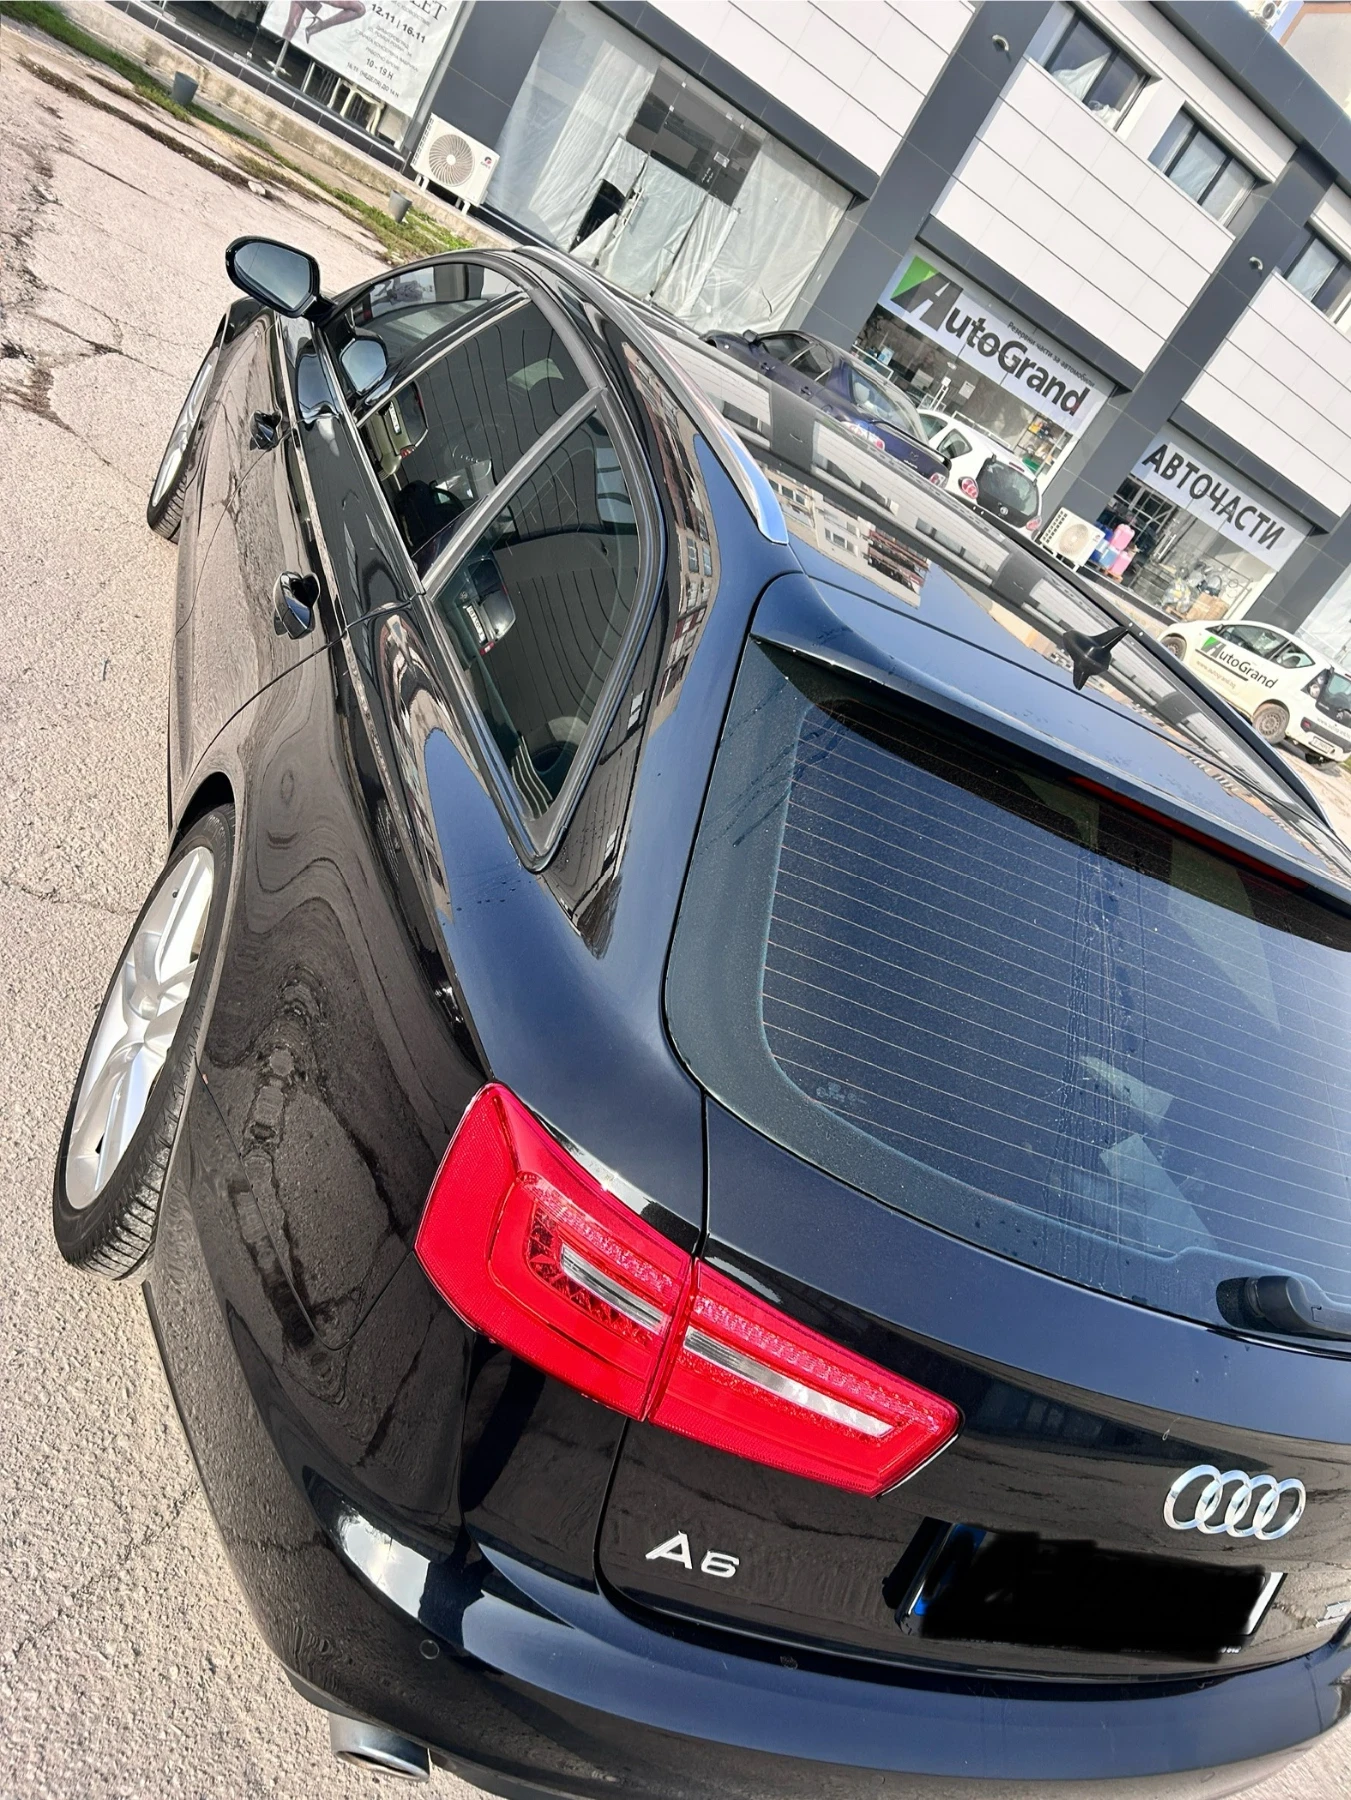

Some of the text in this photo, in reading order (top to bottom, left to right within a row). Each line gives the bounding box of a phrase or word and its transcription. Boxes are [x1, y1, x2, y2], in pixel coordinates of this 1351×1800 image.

[371, 4, 395, 23] 12.11
[402, 24, 426, 43] 16.11
[366, 58, 375, 68] 10
[379, 66, 388, 76] 19
[890, 255, 1091, 417] AutoGrand
[1007, 321, 1096, 388] Резервни части за автомобили
[1141, 444, 1286, 550] АВТОЧАСТИ
[1200, 636, 1279, 689] AutoGrand
[645, 1530, 740, 1578] A6
